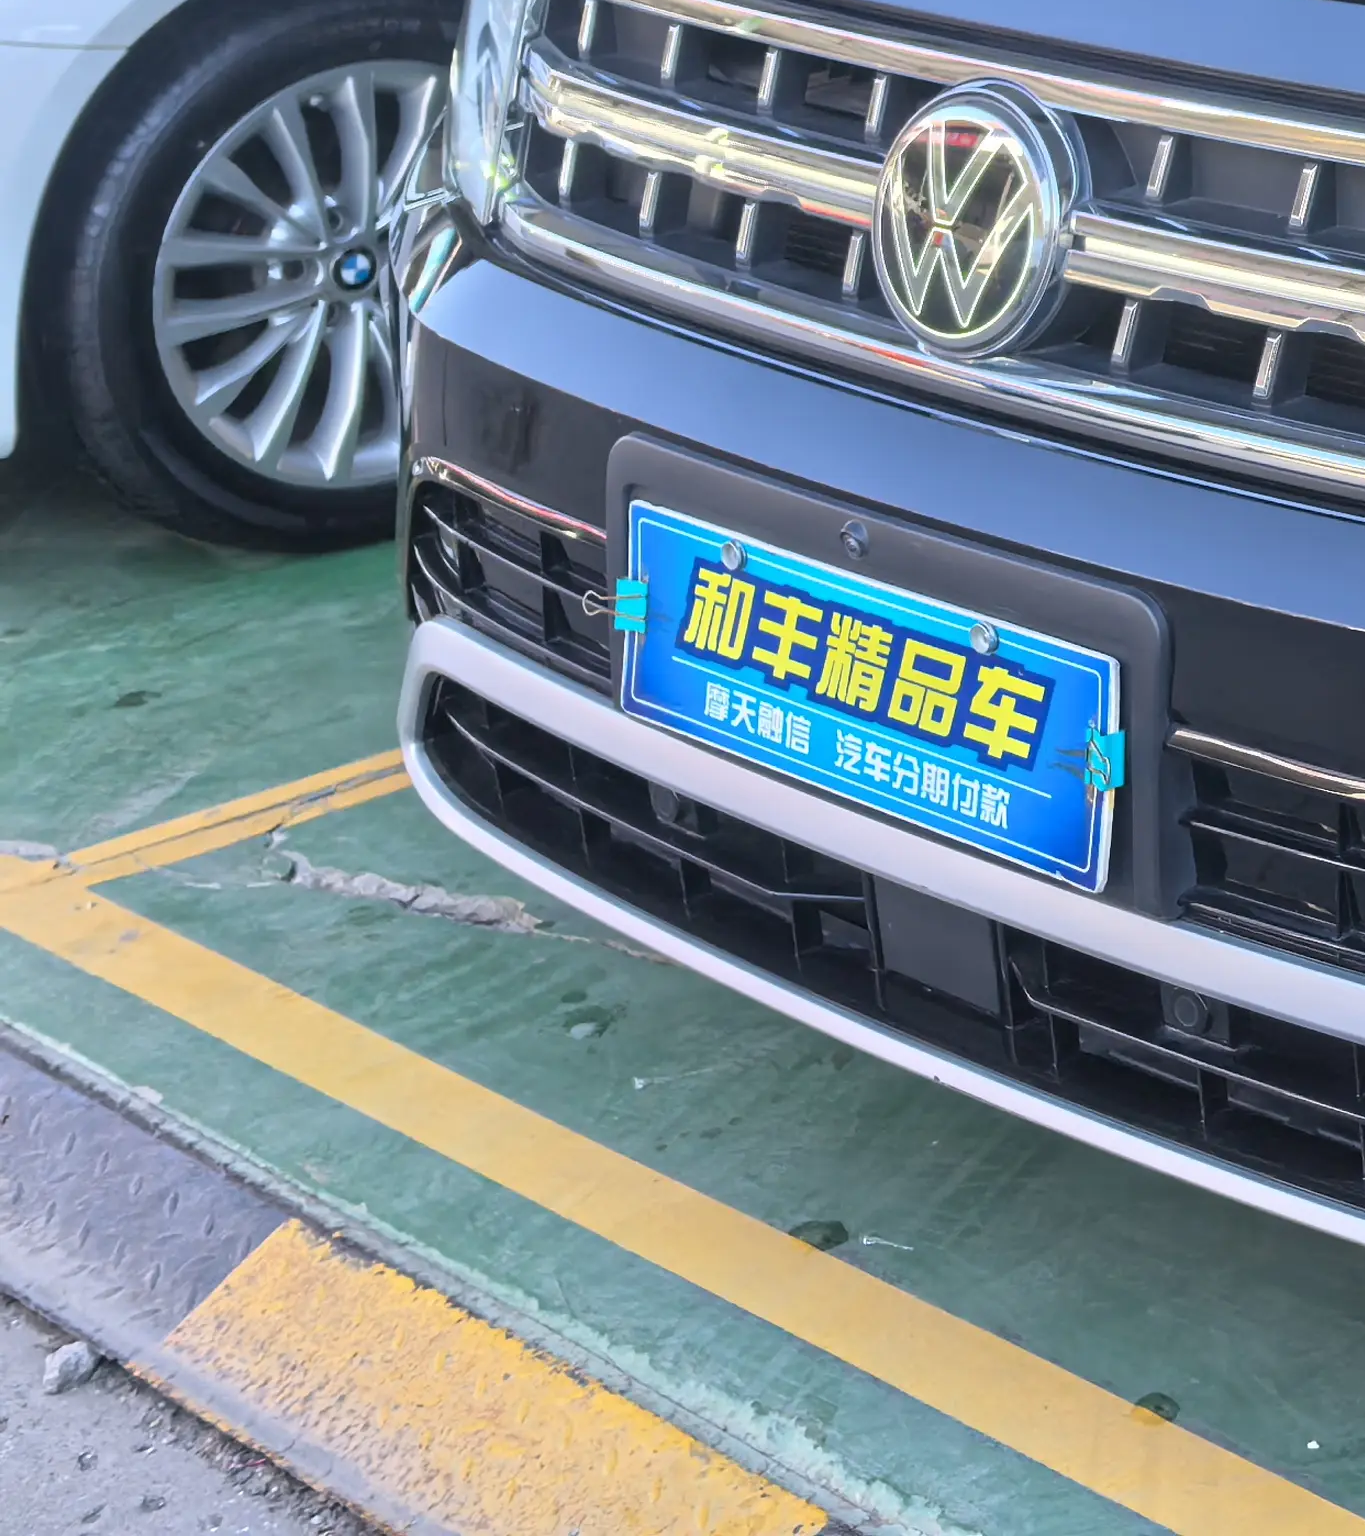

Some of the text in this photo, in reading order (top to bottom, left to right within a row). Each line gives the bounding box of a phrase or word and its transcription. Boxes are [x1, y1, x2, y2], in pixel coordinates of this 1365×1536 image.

[682, 566, 1046, 760] 和丰精品车
[702, 681, 1011, 830] 摩天融信 汽车分期付款
